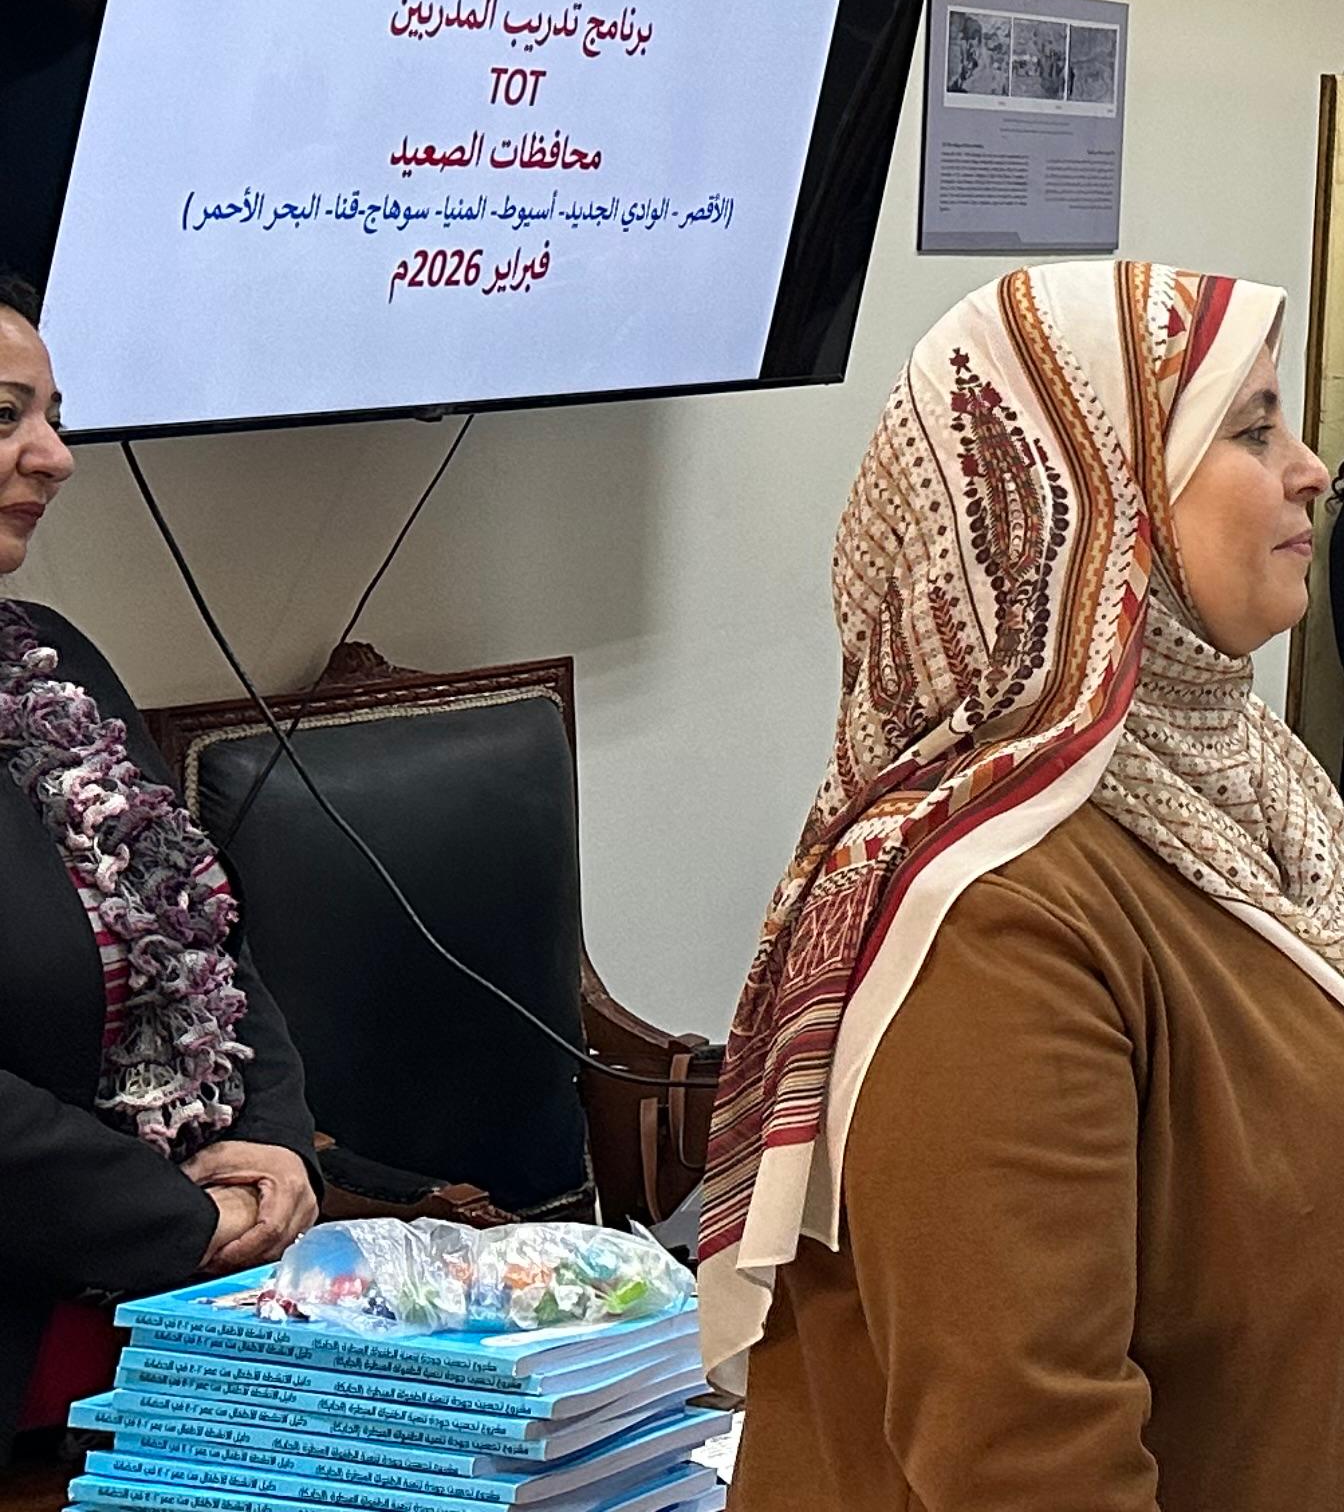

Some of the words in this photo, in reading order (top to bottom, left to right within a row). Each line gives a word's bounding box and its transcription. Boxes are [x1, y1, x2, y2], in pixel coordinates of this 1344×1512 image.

[503, 2, 582, 53] تدريب
[581, 6, 653, 58] برنامج
[490, 67, 547, 107] TOT
[390, 129, 486, 179] الصعيد
[489, 128, 602, 171] محافظات
[262, 192, 322, 231] البحر
[620, 197, 671, 233] الوادي
[481, 239, 551, 296] فبراير
